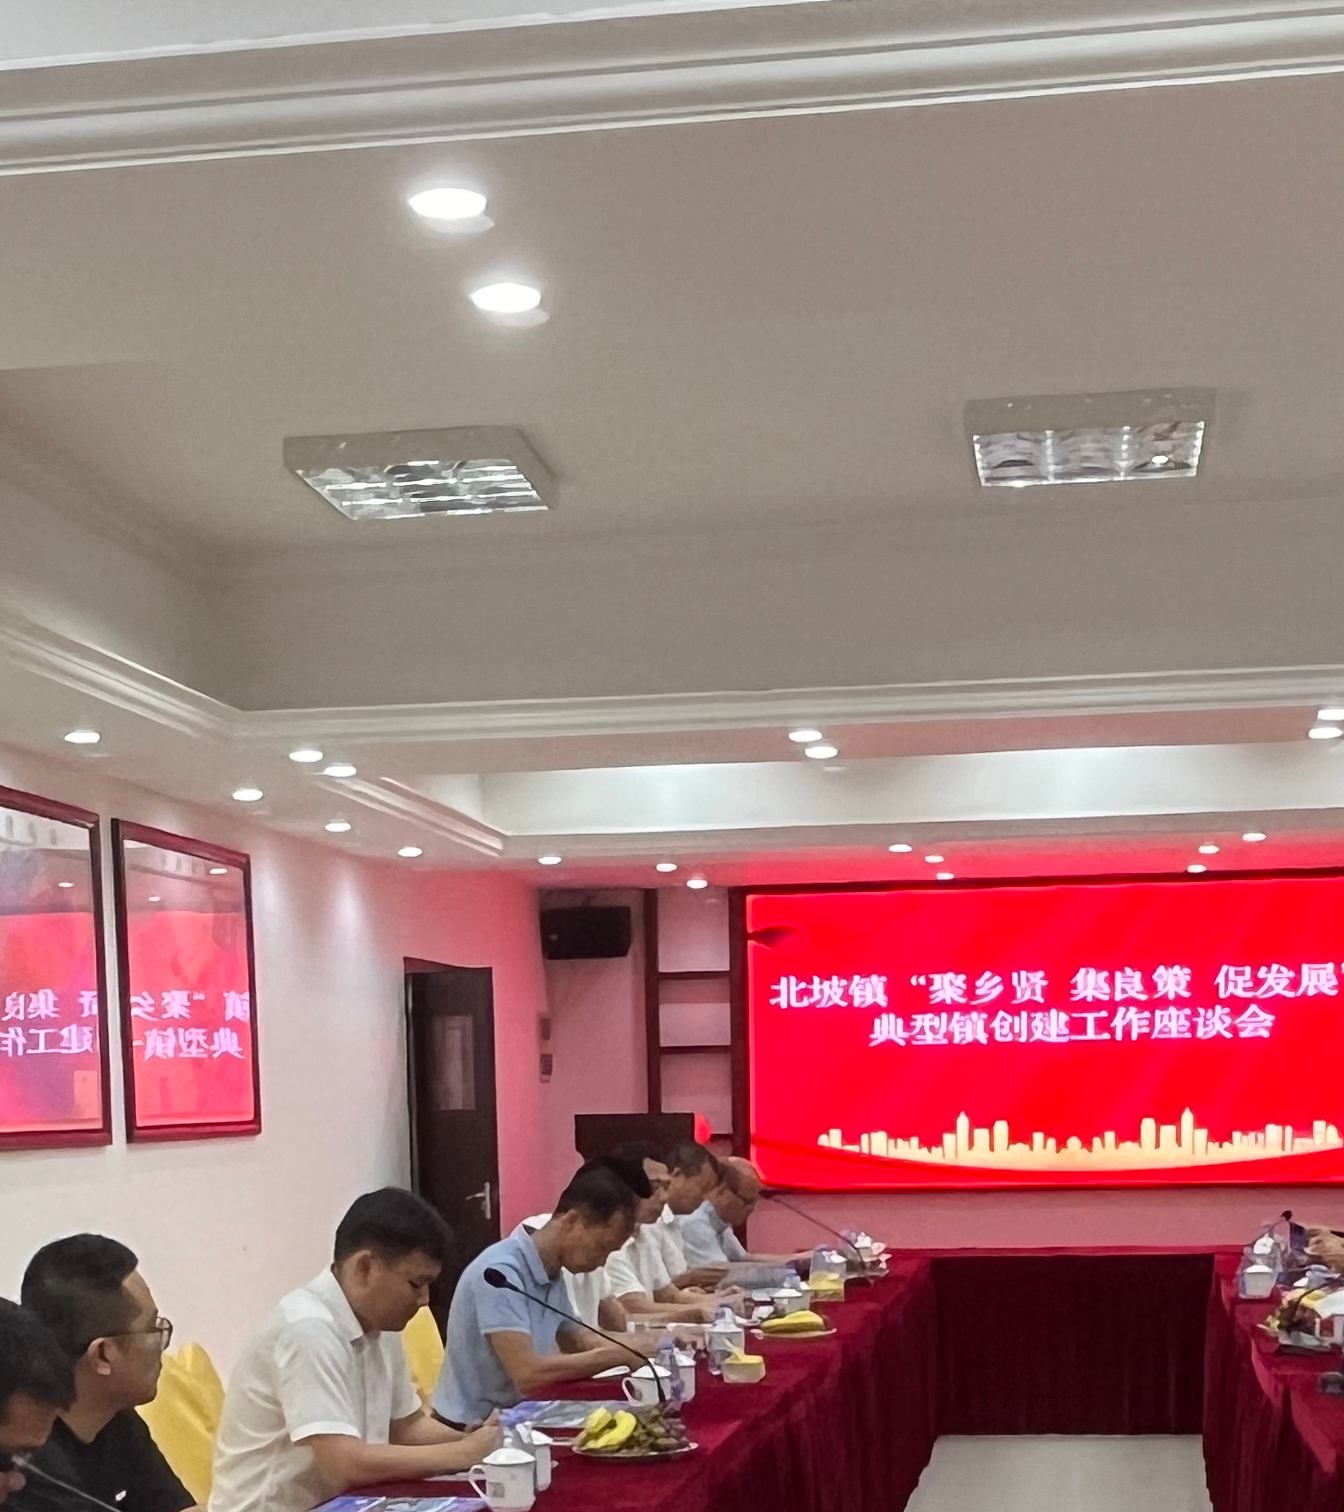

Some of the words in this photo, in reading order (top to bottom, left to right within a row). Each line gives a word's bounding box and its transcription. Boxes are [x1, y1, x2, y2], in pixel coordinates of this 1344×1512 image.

[768, 974, 889, 1010] 北坡镇
[1070, 964, 1193, 1002] 集良策
[868, 1003, 1276, 1048] 典型镇创建工作座谈会
